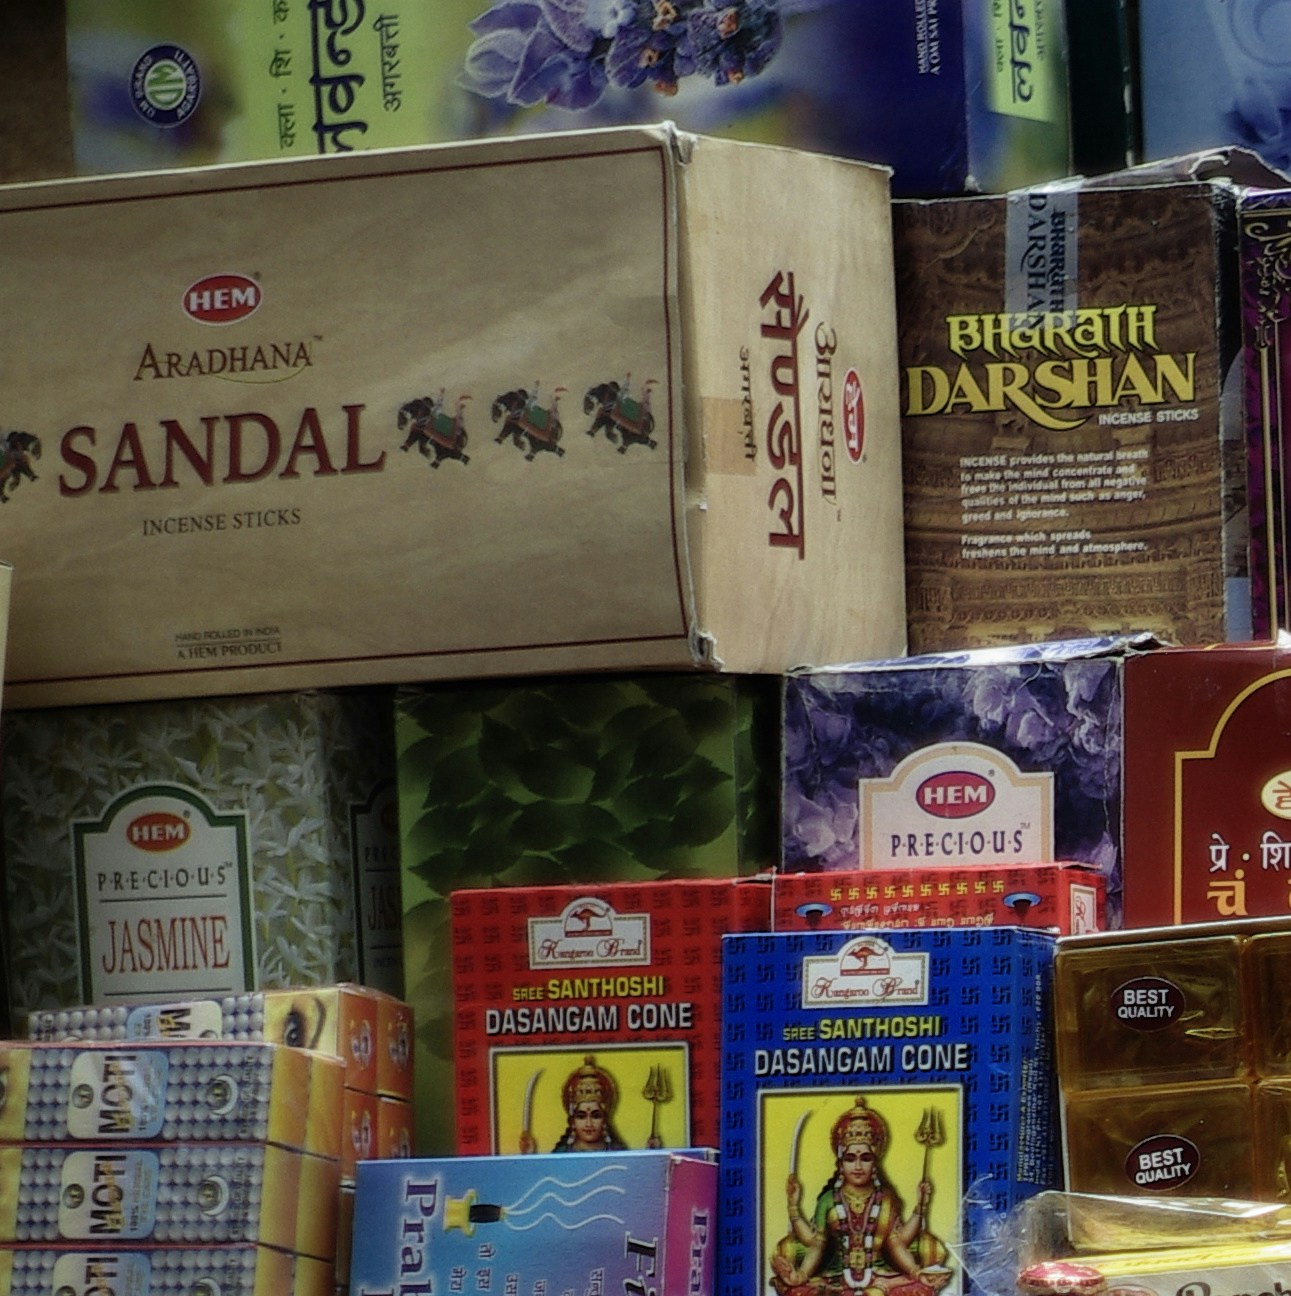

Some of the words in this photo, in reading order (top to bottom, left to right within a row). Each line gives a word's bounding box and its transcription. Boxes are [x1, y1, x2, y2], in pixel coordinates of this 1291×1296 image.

[1020, 193, 1048, 331] DARSHAN
[188, 286, 256, 312] HEM
[133, 342, 314, 381] ARADHANA
[906, 352, 1197, 431] DARSHAN
[759, 270, 810, 561] सैण्डल
[814, 320, 838, 506] आराधना
[1099, 411, 1151, 425] INCENSE
[1156, 408, 1199, 422] STICKS
[57, 404, 388, 498] SANDAL
[960, 456, 1007, 467] INCENSE
[1010, 454, 1054, 466] provides
[1057, 453, 1074, 463] the
[1077, 452, 1113, 462] natural
[1116, 450, 1148, 460] breath
[961, 472, 970, 482] to
[974, 471, 1001, 481] make
[1004, 470, 1020, 479] the
[1024, 468, 1049, 478] mind
[1052, 466, 1112, 477] concentrate
[1115, 464, 1135, 474] and
[961, 483, 986, 494] frees
[989, 483, 1005, 493] the
[1008, 480, 1058, 491] individual
[1061, 479, 1086, 490] from
[1088, 478, 1101, 488] all
[1103, 476, 1147, 489] negative
[961, 496, 1005, 509] qualities
[1008, 496, 1019, 505] of
[1021, 495, 1037, 504] the
[1040, 493, 1066, 503] mind
[1069, 492, 1094, 502] such
[1098, 492, 1111, 501] as
[1113, 489, 1147, 502] anger,
[142, 514, 226, 536] INCENSE
[232, 508, 301, 529] STICKS
[962, 511, 991, 524] greed
[994, 510, 1012, 519] and
[1017, 508, 1070, 522] ignorance.
[961, 534, 1012, 547] Fragrance
[1015, 532, 1046, 543] which
[1050, 530, 1092, 543] spreads
[962, 548, 1007, 559] freshens
[1010, 546, 1026, 556] the
[1029, 545, 1055, 555] mind
[1059, 543, 1079, 554] and
[1082, 541, 1148, 554] atmosphere.
[177, 648, 186, 660] A
[188, 645, 218, 660] HEM
[221, 642, 282, 658] PRODUCT
[923, 785, 989, 805] HEM
[132, 823, 185, 842] HEM
[102, 915, 231, 975] JASMINE
[512, 987, 545, 1000] SREE
[548, 976, 664, 999] SANTHOSHI
[1123, 987, 1170, 1006] BEST
[485, 1004, 618, 1035] DASANGAM
[626, 1002, 693, 1030] CONE
[1117, 1001, 1175, 1020] QUALITY
[783, 1026, 816, 1041] SREE
[818, 1015, 941, 1039] SANTHOSHI
[754, 1044, 891, 1075] DASANGAM
[901, 1042, 969, 1071] CONE
[98, 1055, 137, 1134] MOTI
[89, 1155, 127, 1234] MOTI
